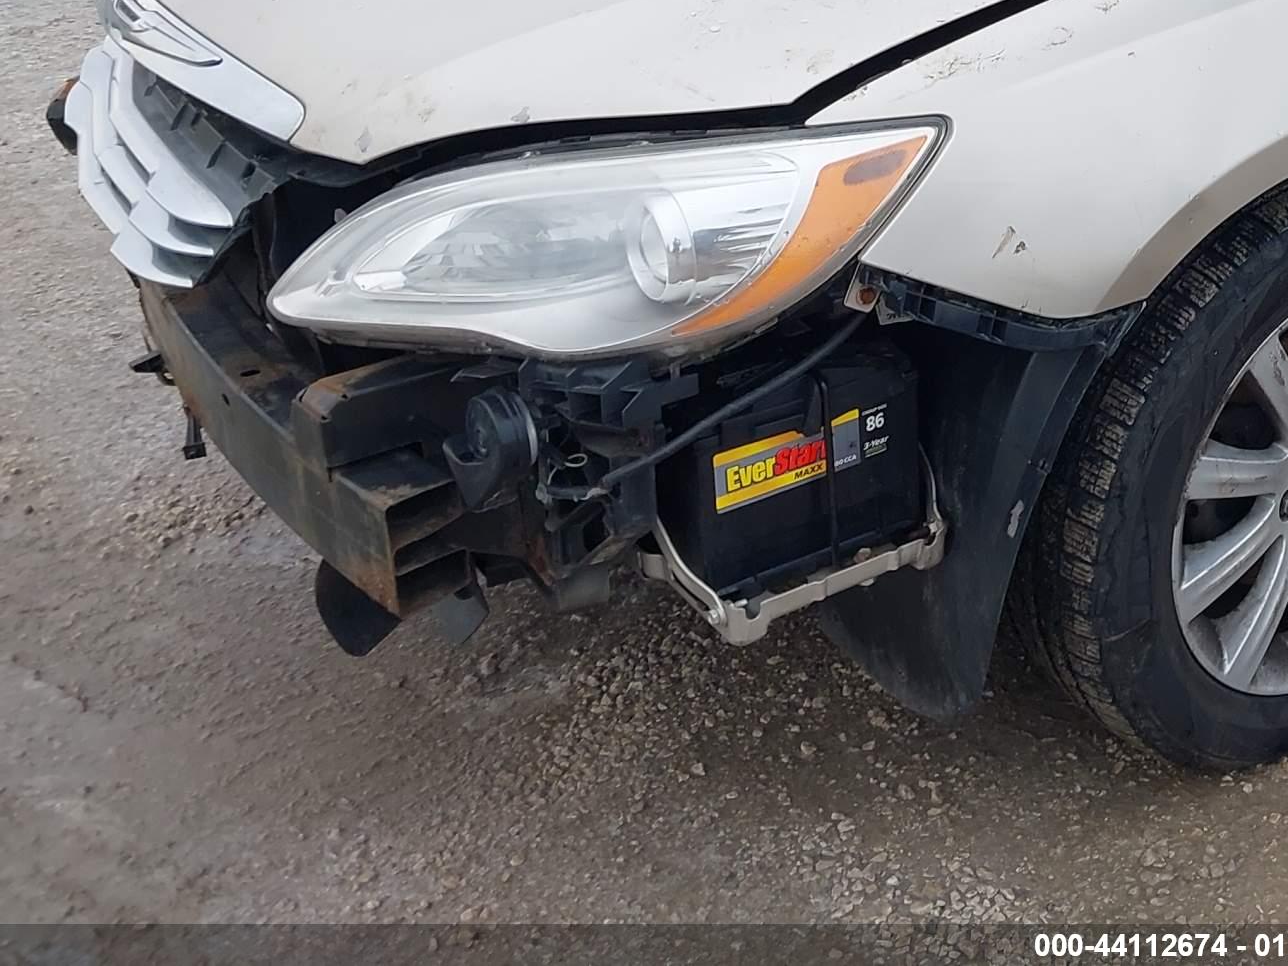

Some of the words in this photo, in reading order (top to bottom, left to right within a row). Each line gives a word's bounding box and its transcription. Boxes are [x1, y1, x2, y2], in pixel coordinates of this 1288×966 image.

[866, 412, 885, 432] 86
[863, 435, 889, 451] 3-Year
[794, 462, 825, 481] MAXX
